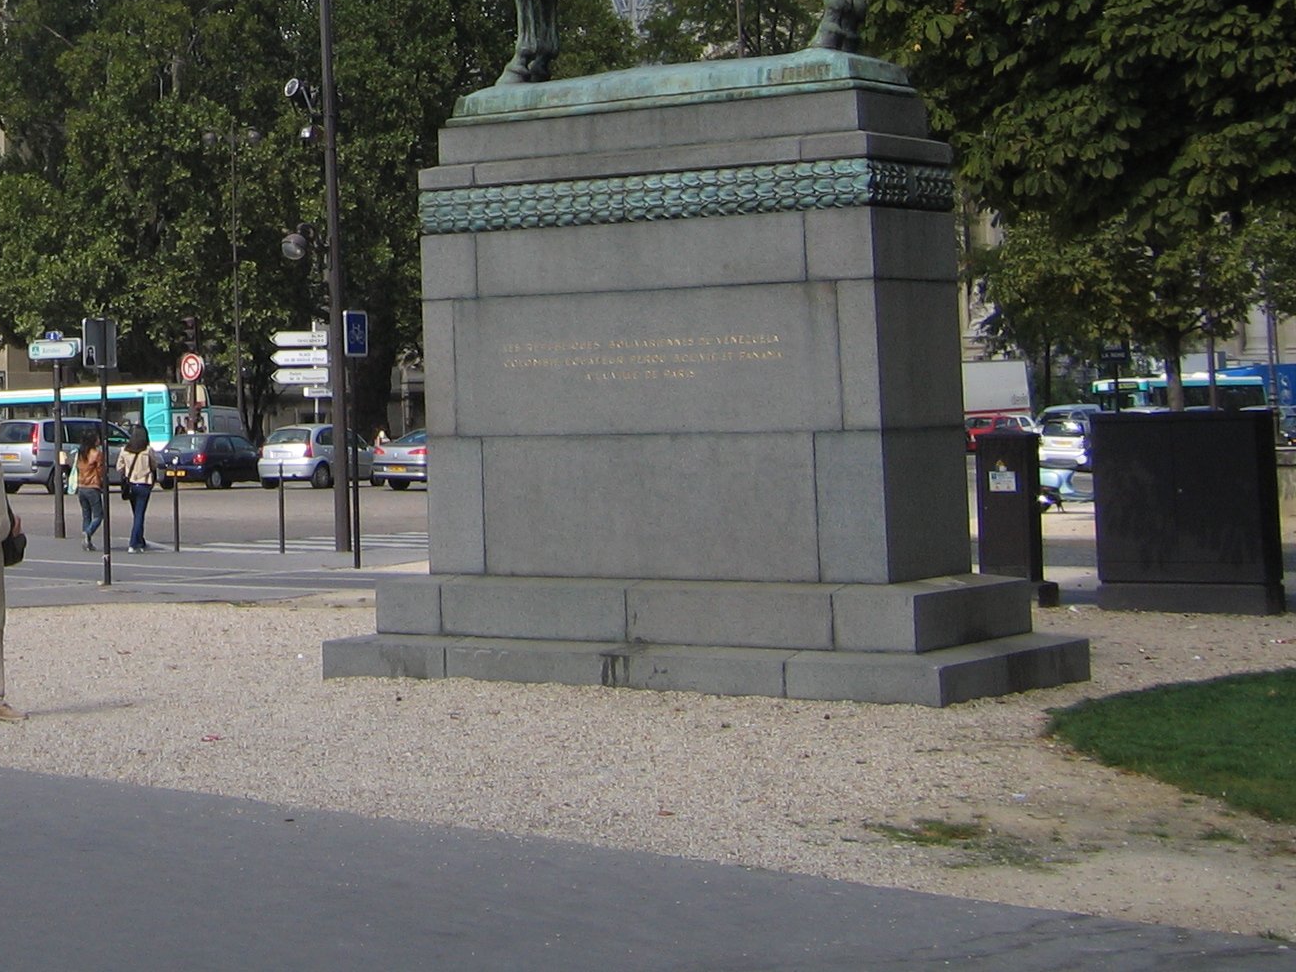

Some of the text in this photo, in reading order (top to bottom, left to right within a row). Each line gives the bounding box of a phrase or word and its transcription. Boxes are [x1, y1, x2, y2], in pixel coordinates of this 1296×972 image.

[714, 333, 781, 345] VENEZUELA
[738, 349, 784, 361] PANAMA
[663, 368, 696, 379] PARIS
